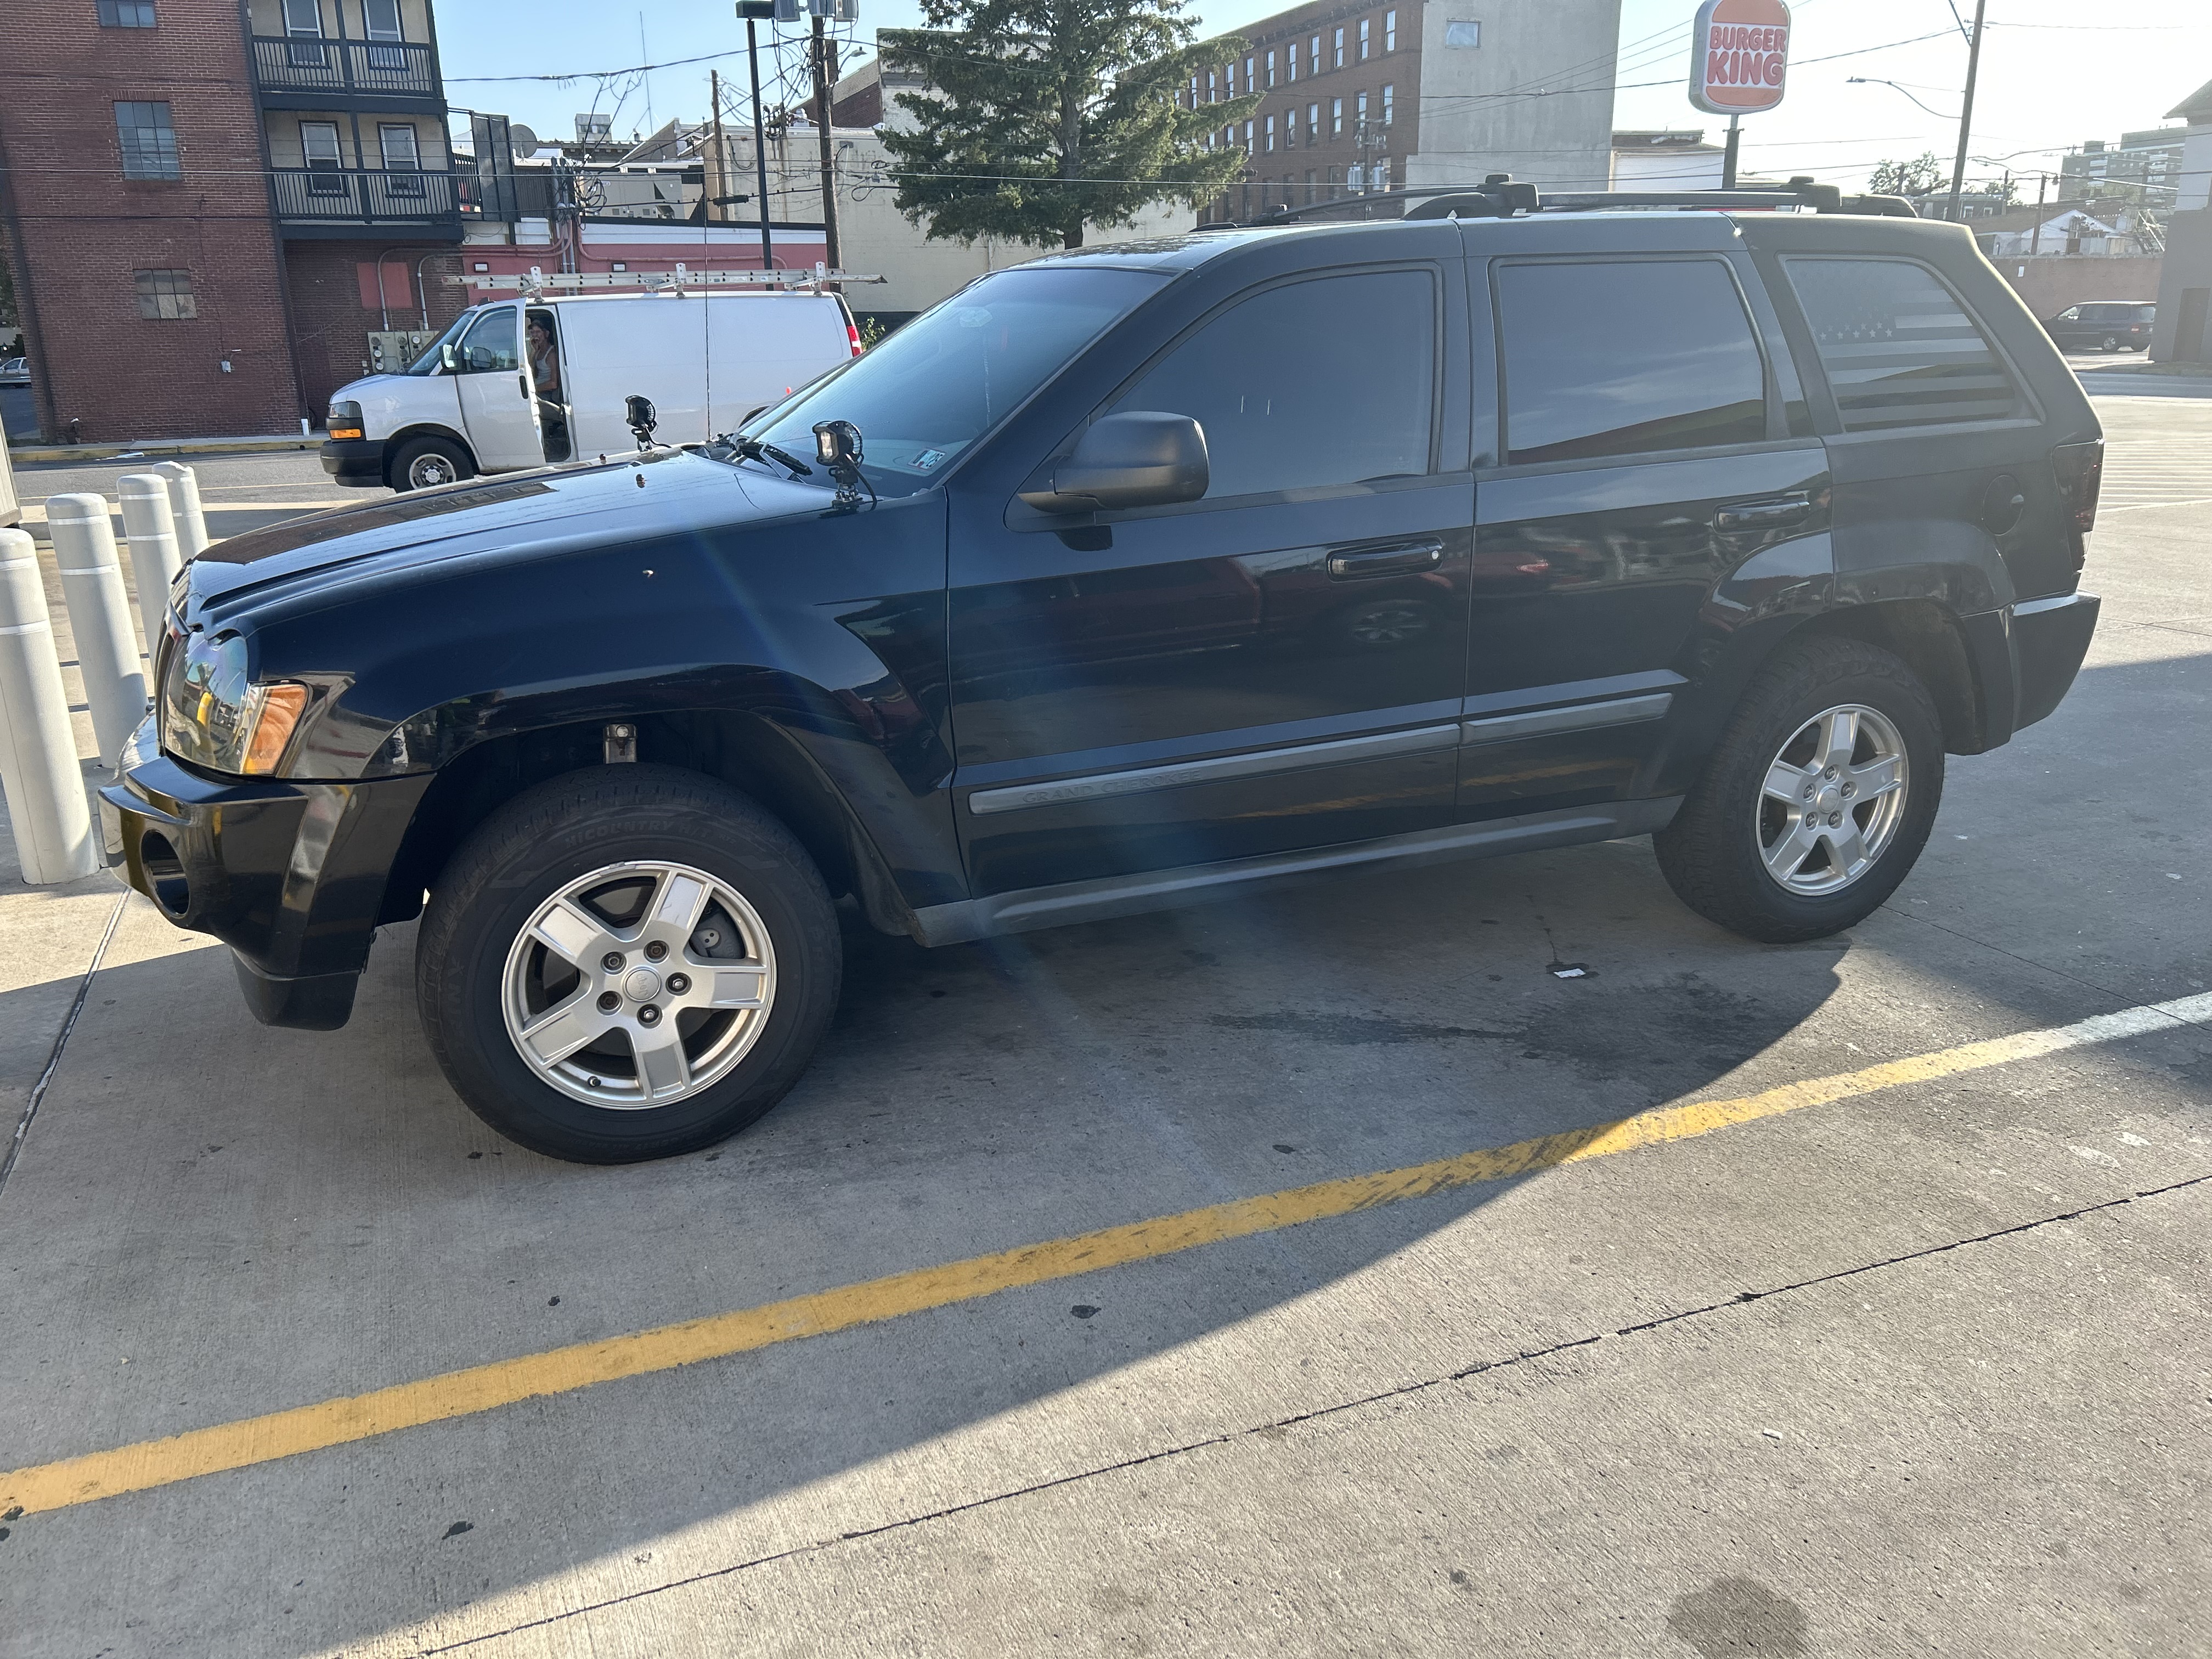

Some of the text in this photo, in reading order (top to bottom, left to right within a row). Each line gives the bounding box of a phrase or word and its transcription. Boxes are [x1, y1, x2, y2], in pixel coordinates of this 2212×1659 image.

[1710, 26, 1786, 52] BURGER
[1707, 50, 1784, 86] KING
[1022, 769, 1202, 803] GRAND CHEROKEE
